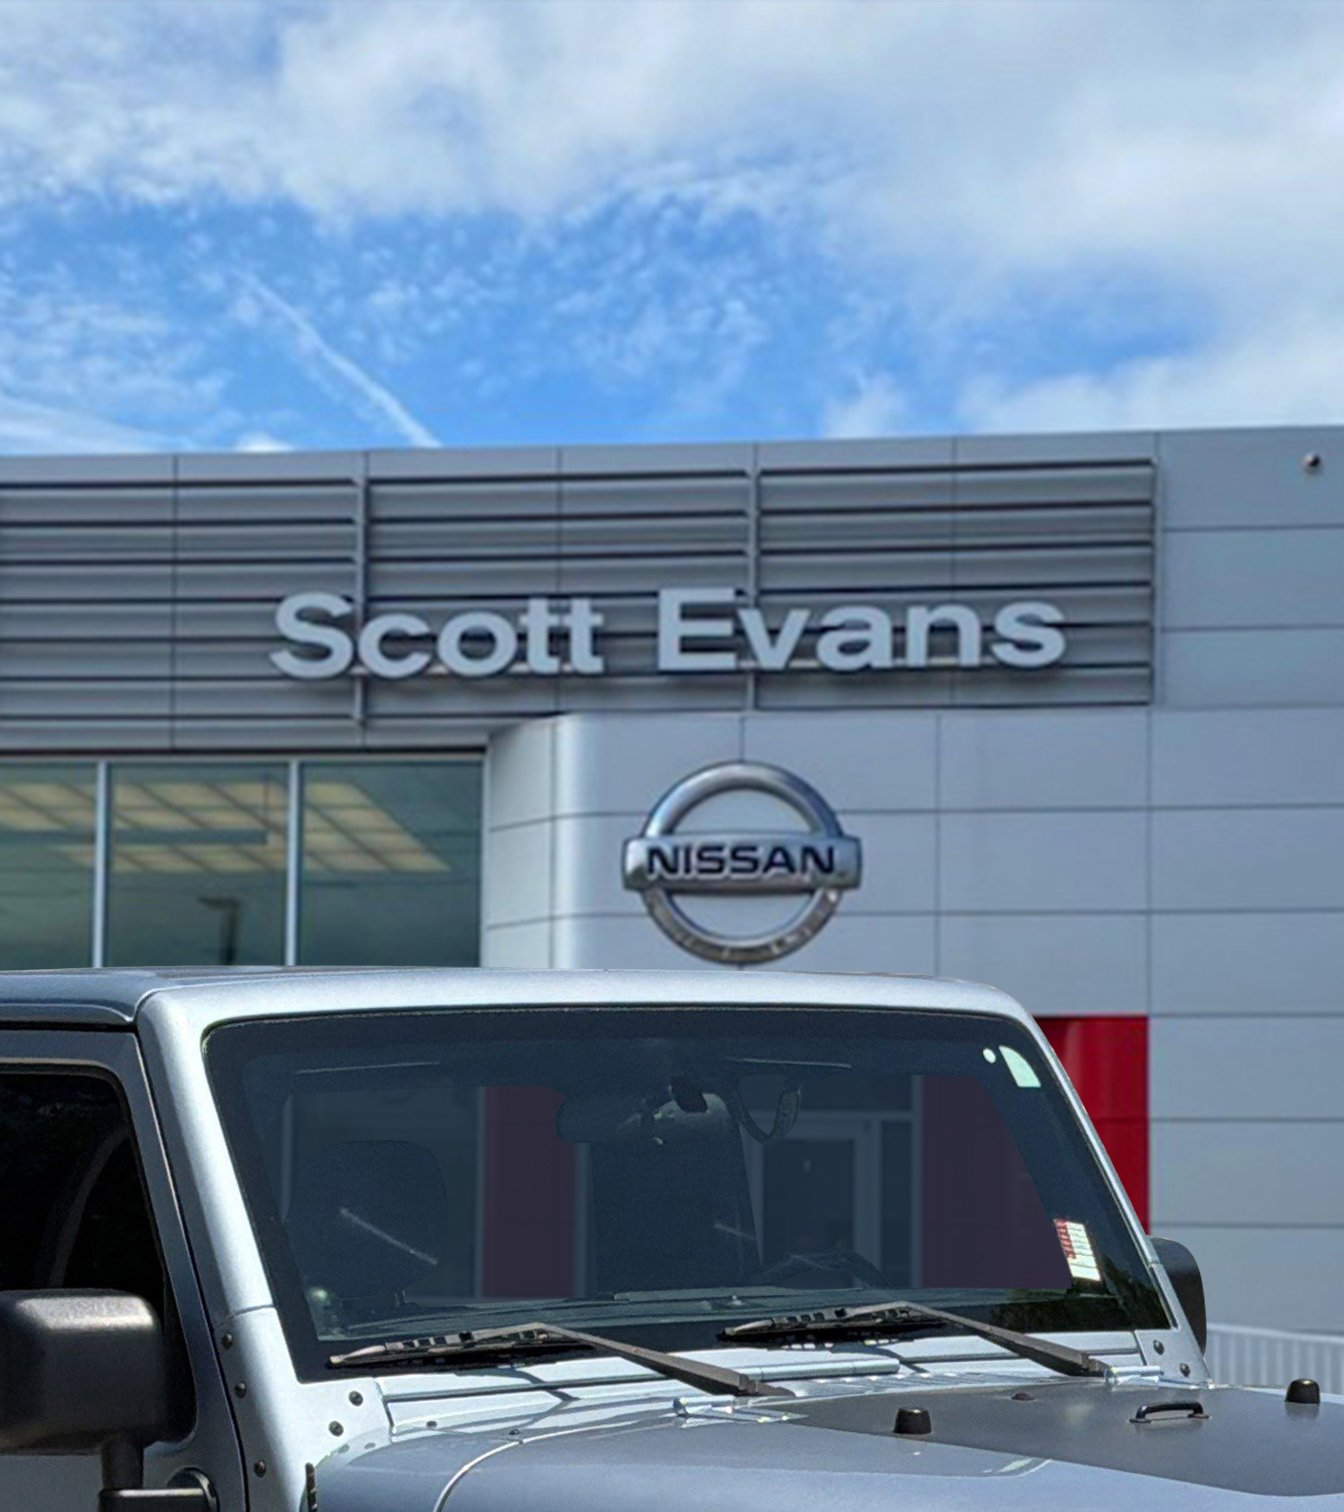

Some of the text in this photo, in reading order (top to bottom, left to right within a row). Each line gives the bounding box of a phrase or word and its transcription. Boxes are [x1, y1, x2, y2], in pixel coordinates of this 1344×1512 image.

[270, 588, 1067, 678] Scott Evans
[645, 844, 837, 877] NISSAN
